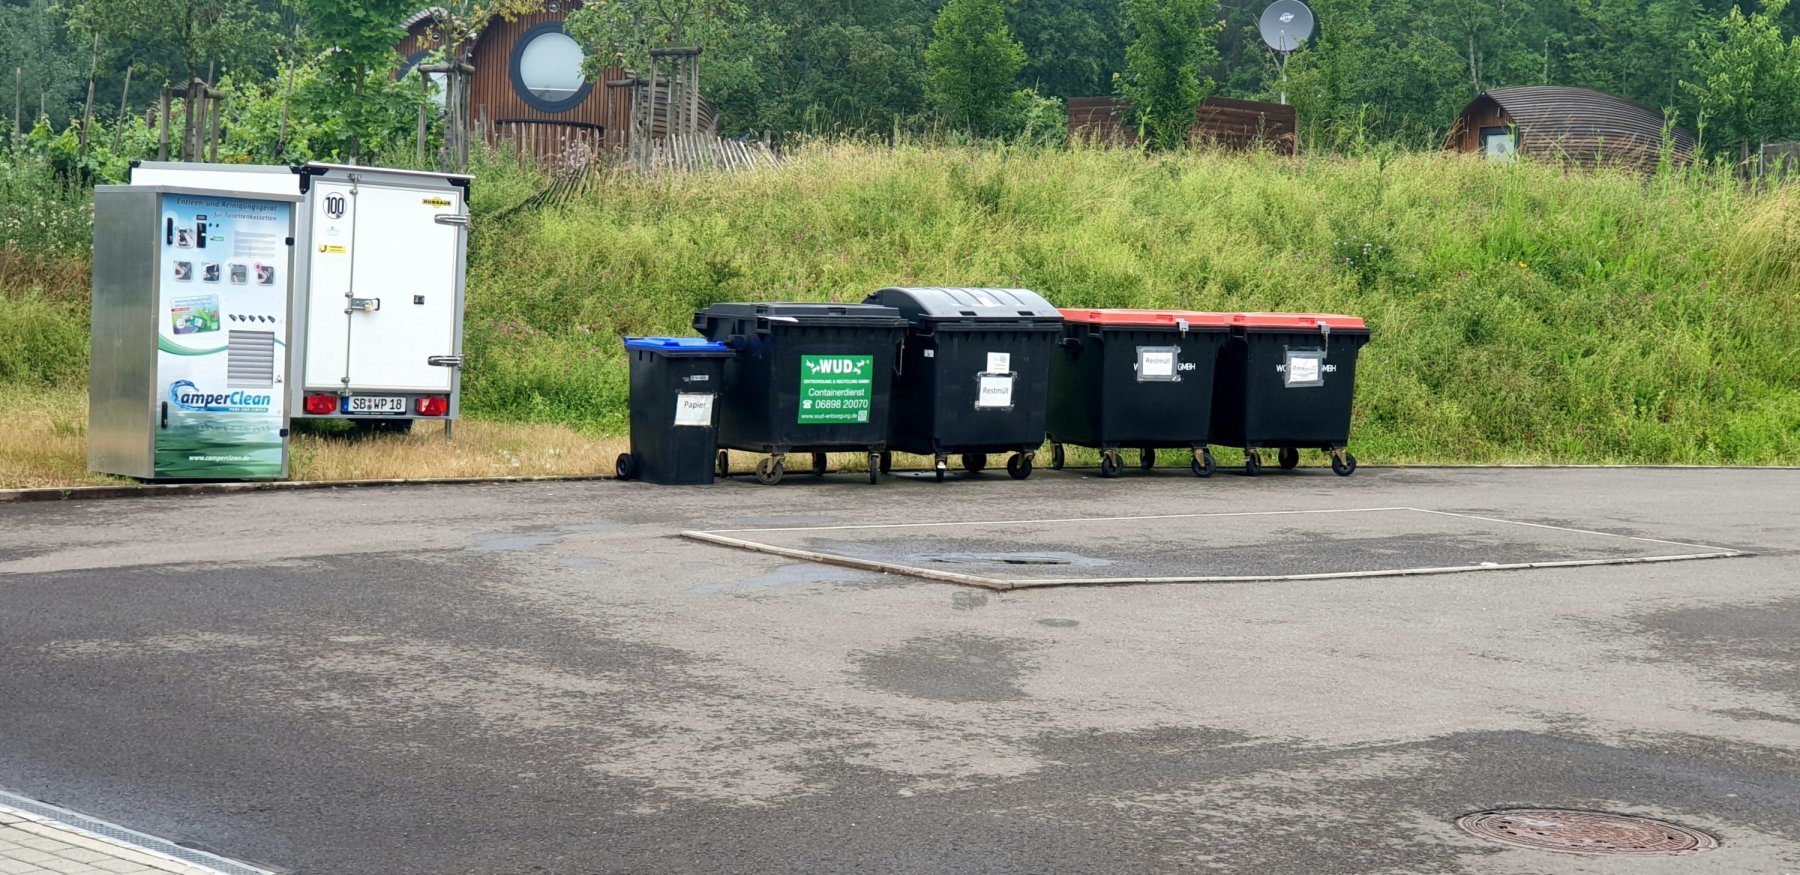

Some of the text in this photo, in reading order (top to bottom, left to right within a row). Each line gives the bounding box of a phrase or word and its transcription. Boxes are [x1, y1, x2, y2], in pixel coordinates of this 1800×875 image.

[325, 196, 345, 215] 100
[423, 198, 451, 206] HUMBAUR
[1145, 356, 1171, 365] Restmüll
[819, 359, 853, 374] WUD
[1177, 362, 1196, 371] GMBH
[808, 388, 865, 397] Containerdienst
[982, 386, 1009, 395] Restmüll
[352, 398, 402, 410] SB WP 18
[683, 400, 706, 410] Papier
[815, 399, 869, 409] 06898 20070
